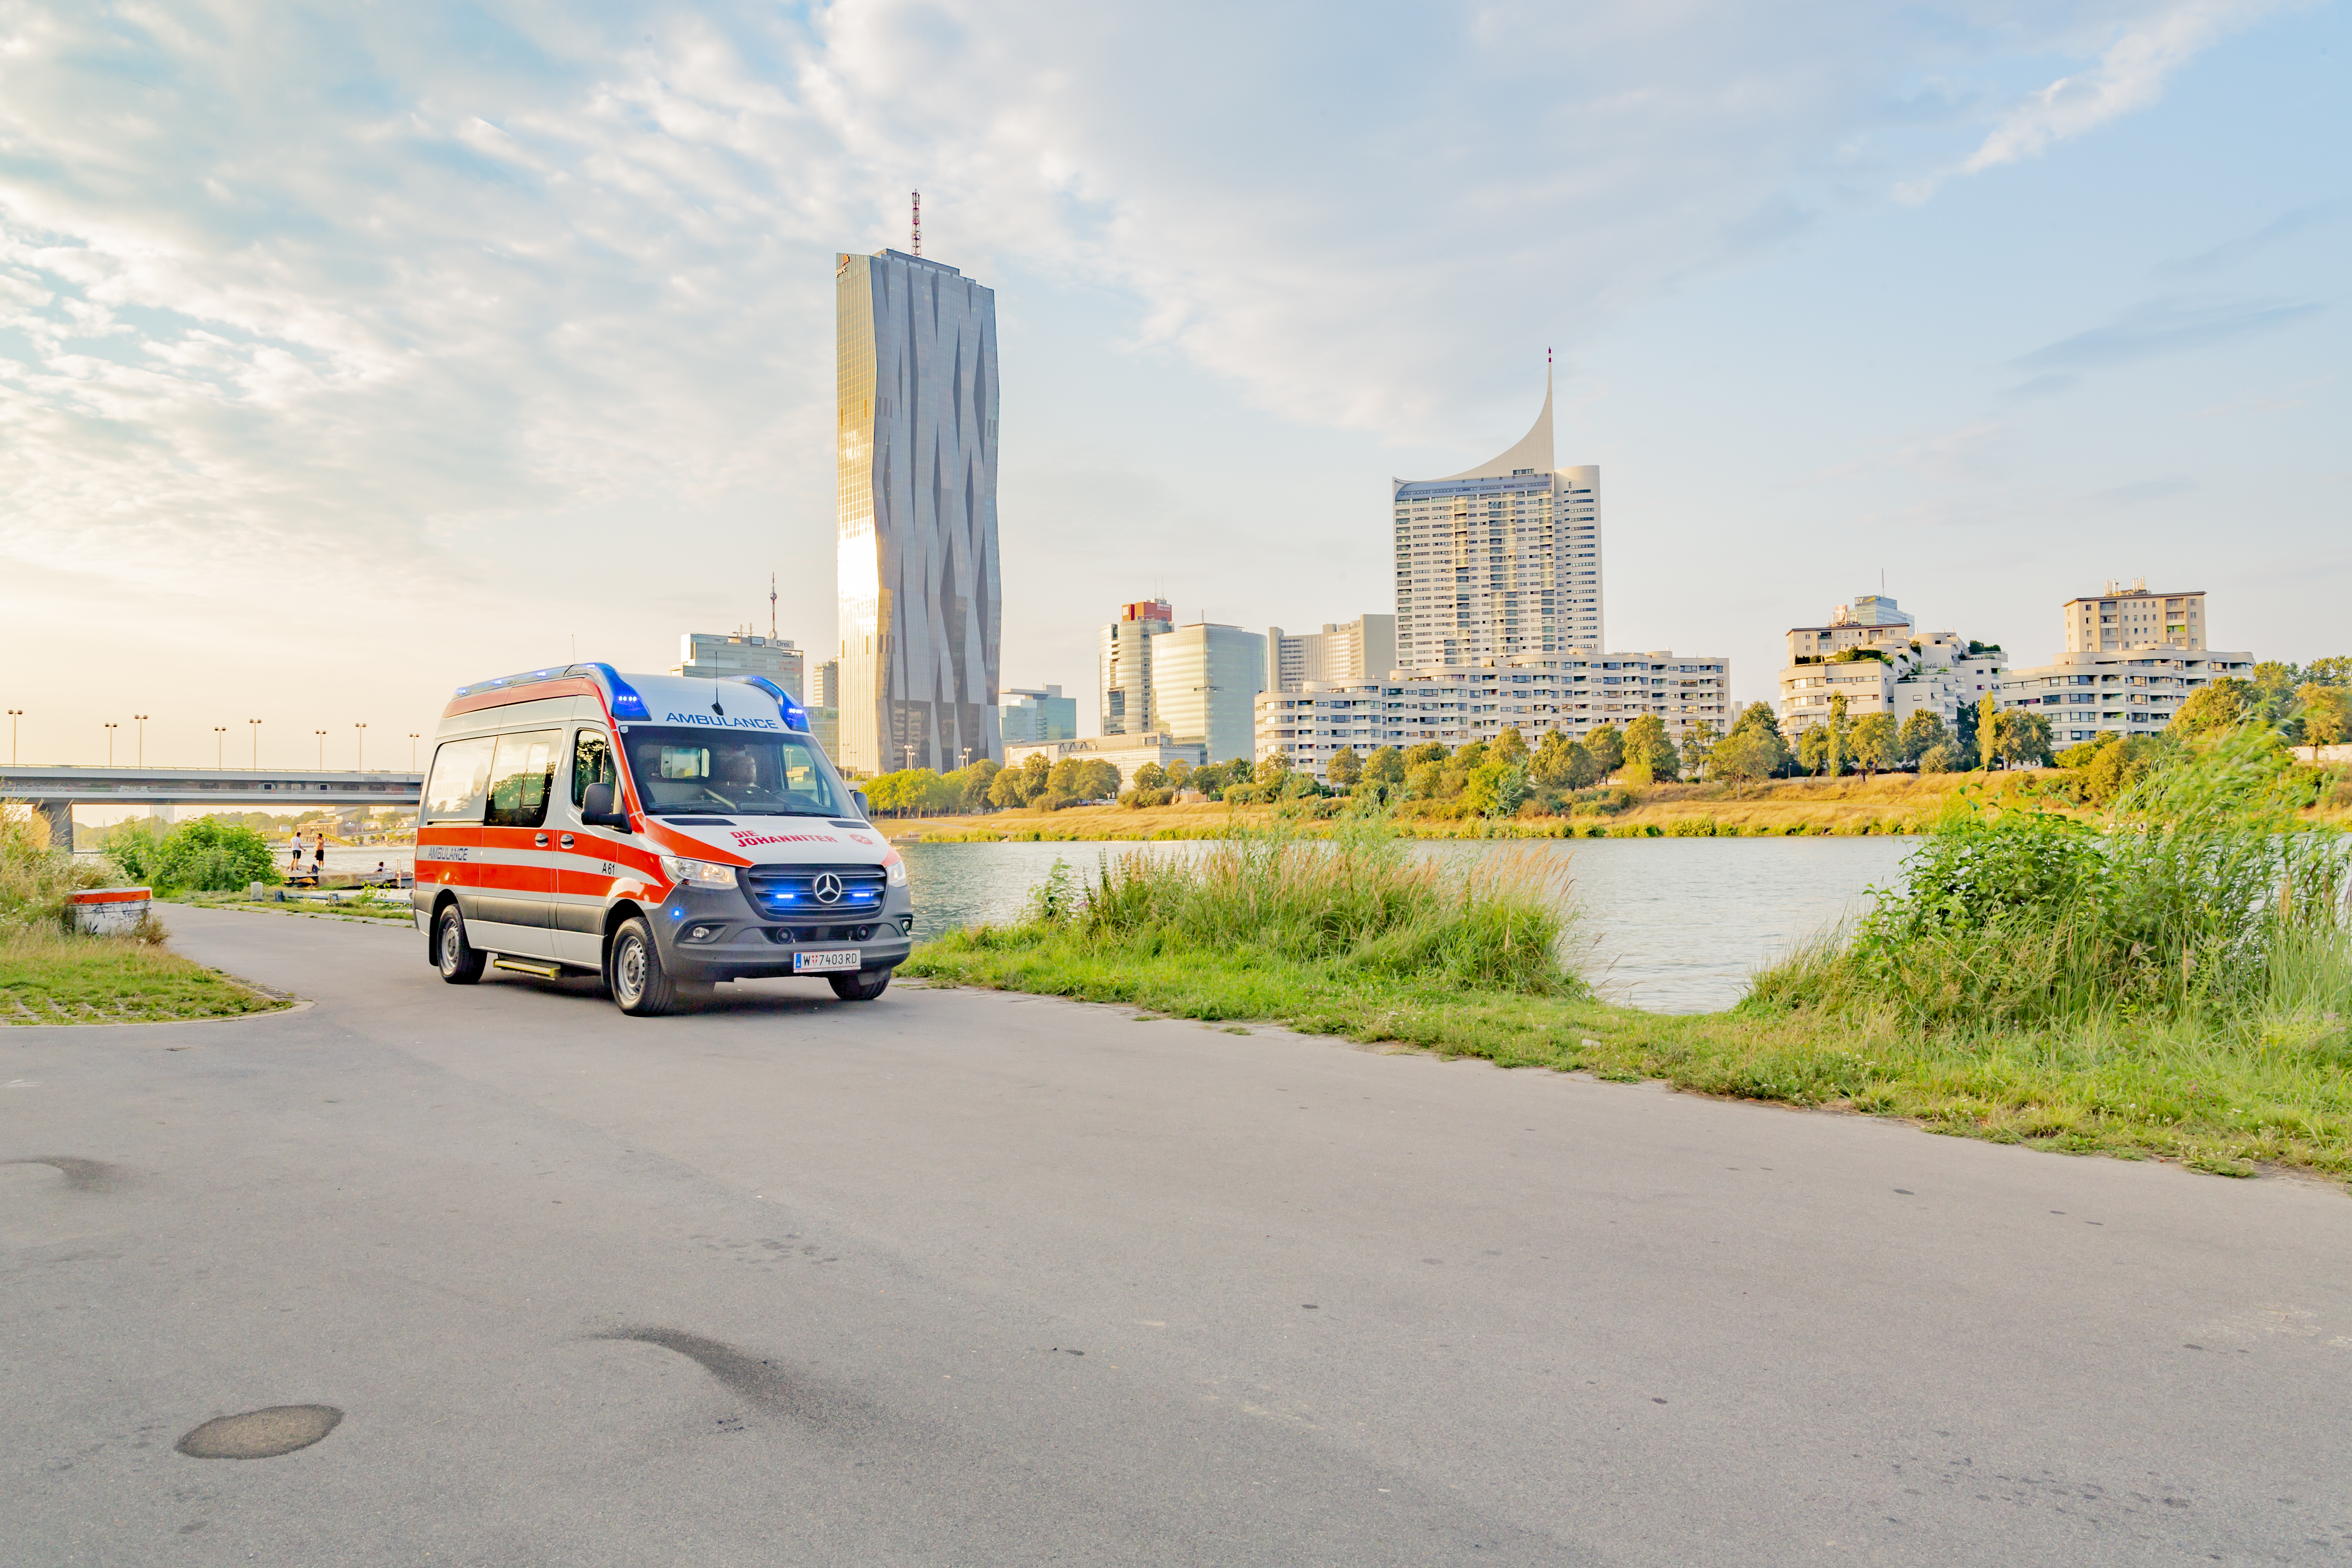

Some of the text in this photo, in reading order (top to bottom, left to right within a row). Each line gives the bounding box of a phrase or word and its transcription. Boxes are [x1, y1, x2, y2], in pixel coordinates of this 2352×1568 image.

[666, 713, 779, 729] AMBULANCE
[729, 830, 759, 838] DIE
[737, 835, 838, 847] JOHANNITER
[428, 847, 468, 860] AMBULANCE
[804, 955, 810, 966] W
